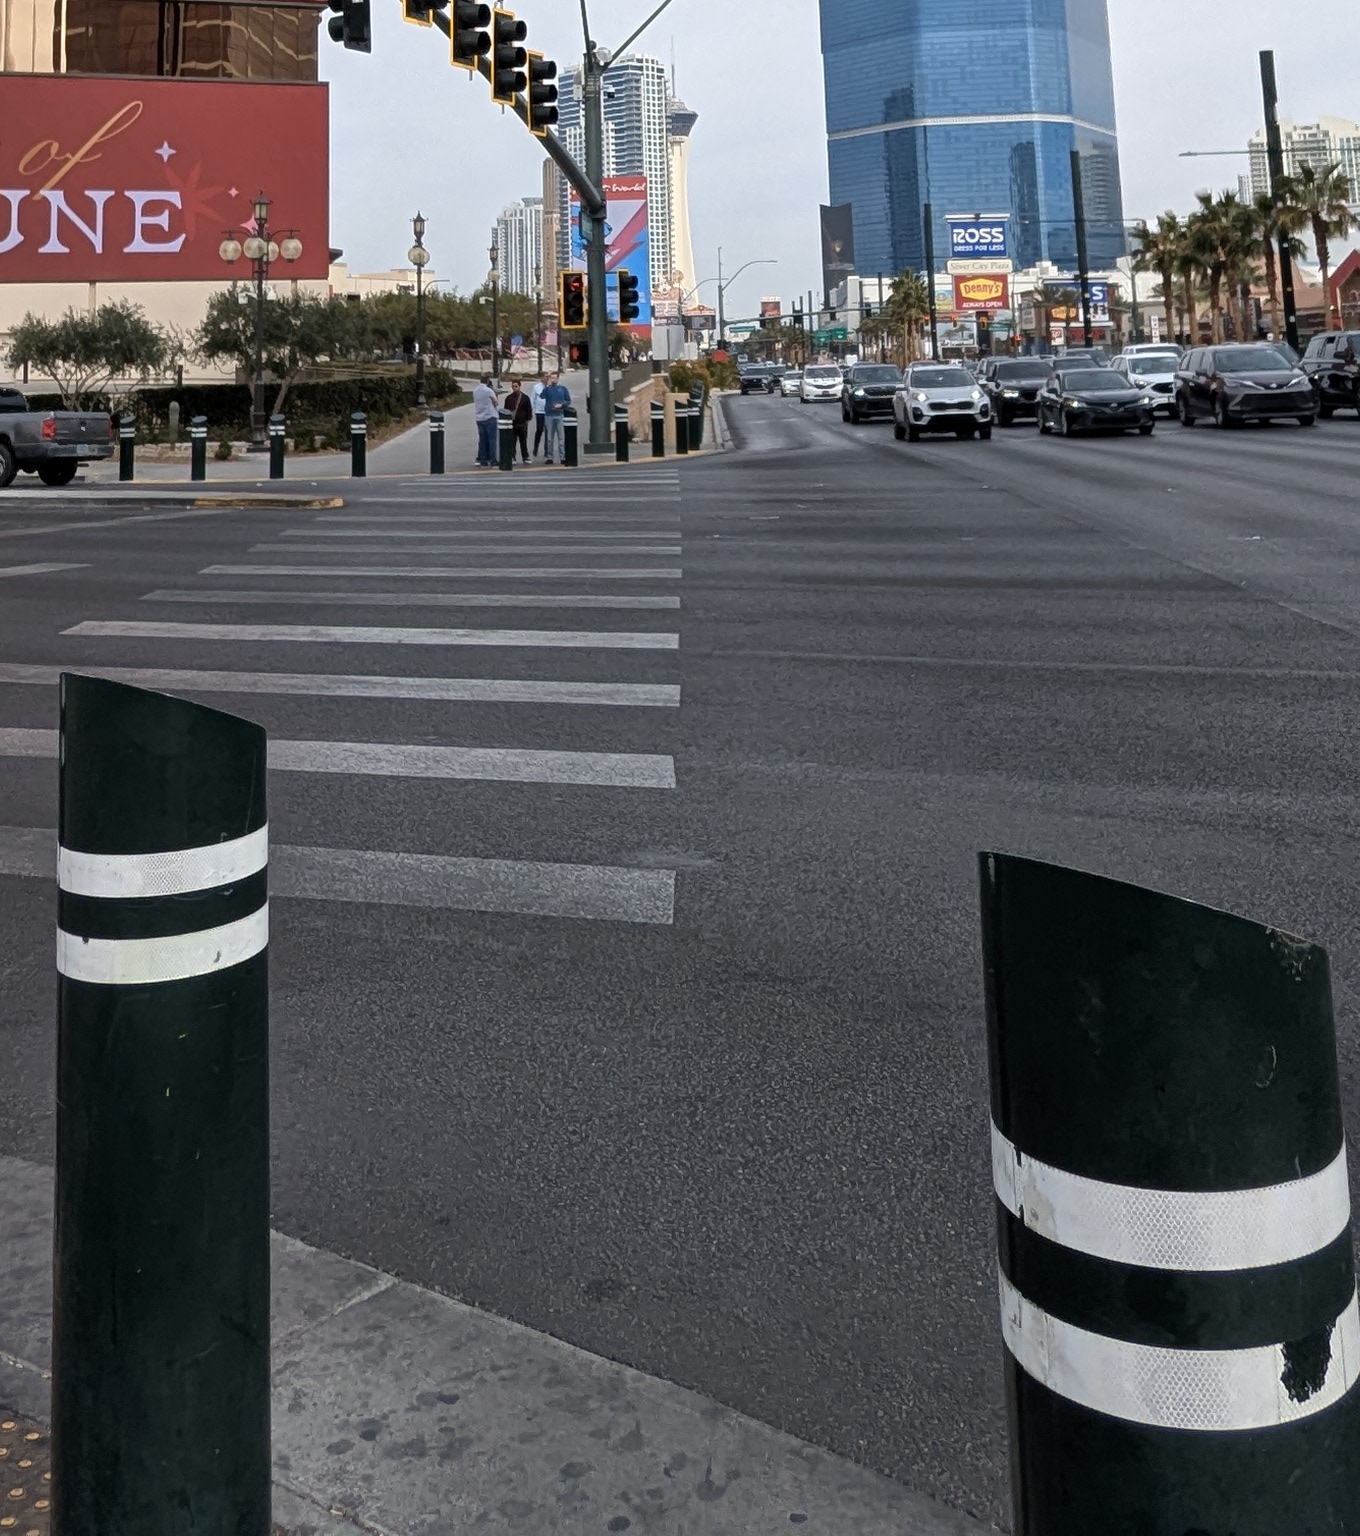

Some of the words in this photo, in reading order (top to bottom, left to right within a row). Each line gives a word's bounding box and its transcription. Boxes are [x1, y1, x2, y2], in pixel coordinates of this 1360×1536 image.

[18, 100, 143, 201] of
[953, 228, 1004, 243] ROSS
[972, 262, 989, 270] City
[963, 281, 1001, 295] Denny's
